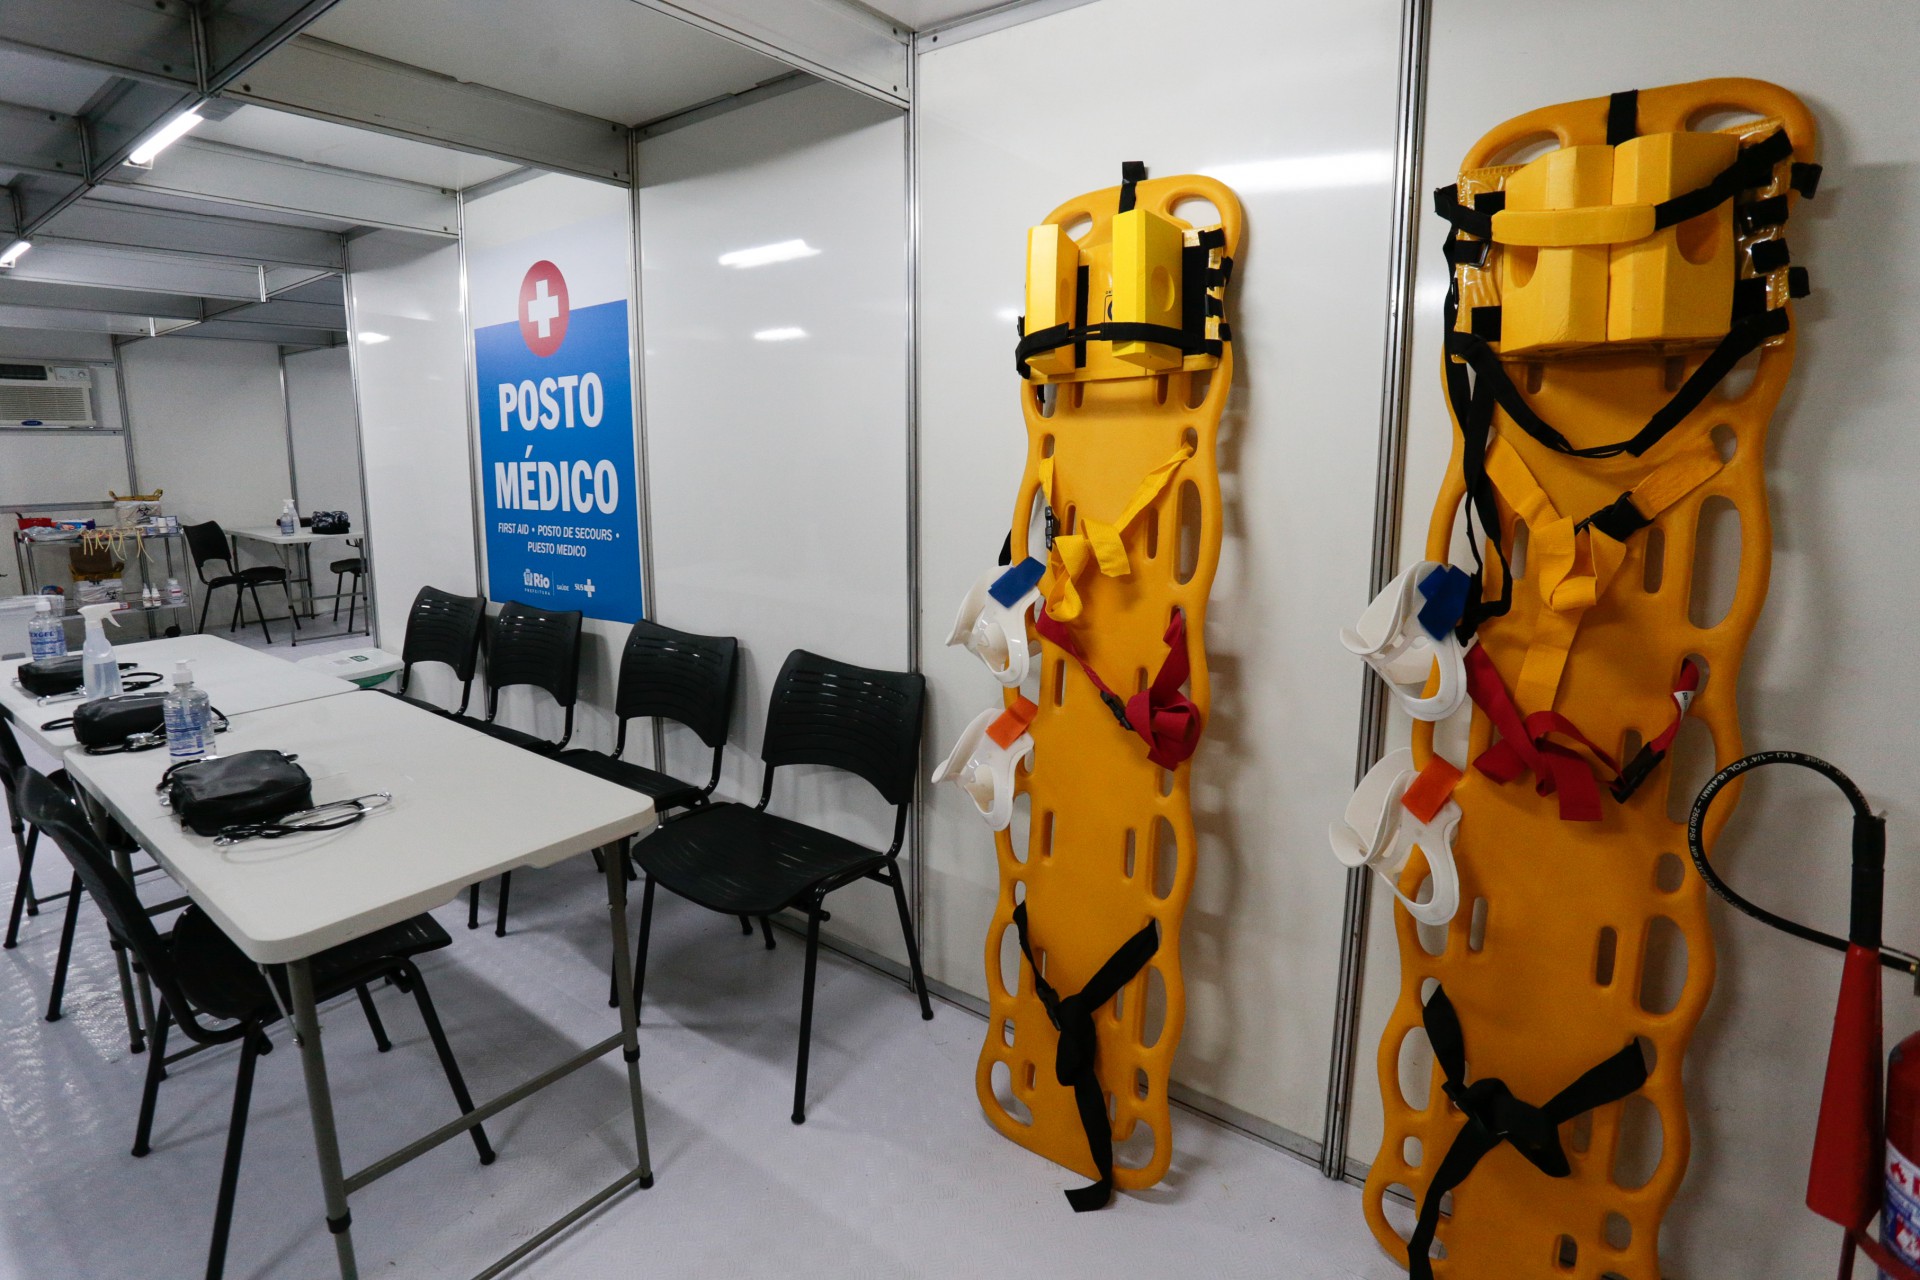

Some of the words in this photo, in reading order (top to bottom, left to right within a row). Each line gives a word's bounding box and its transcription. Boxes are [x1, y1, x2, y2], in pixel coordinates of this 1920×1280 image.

[498, 372, 604, 432] POSTO
[494, 445, 619, 514] MÉDICO
[498, 522, 516, 533] FIRST
[517, 524, 529, 535] AID
[538, 525, 561, 537] POSTO
[563, 526, 574, 538] DE
[575, 527, 613, 541] SECOURS
[528, 541, 555, 554] PUESTO
[556, 544, 586, 557] MEDICO
[533, 572, 550, 588] Rio
[1726, 760, 1748, 772] POL
[1689, 806, 1701, 826] 2500
[1688, 826, 1697, 841] PSI
